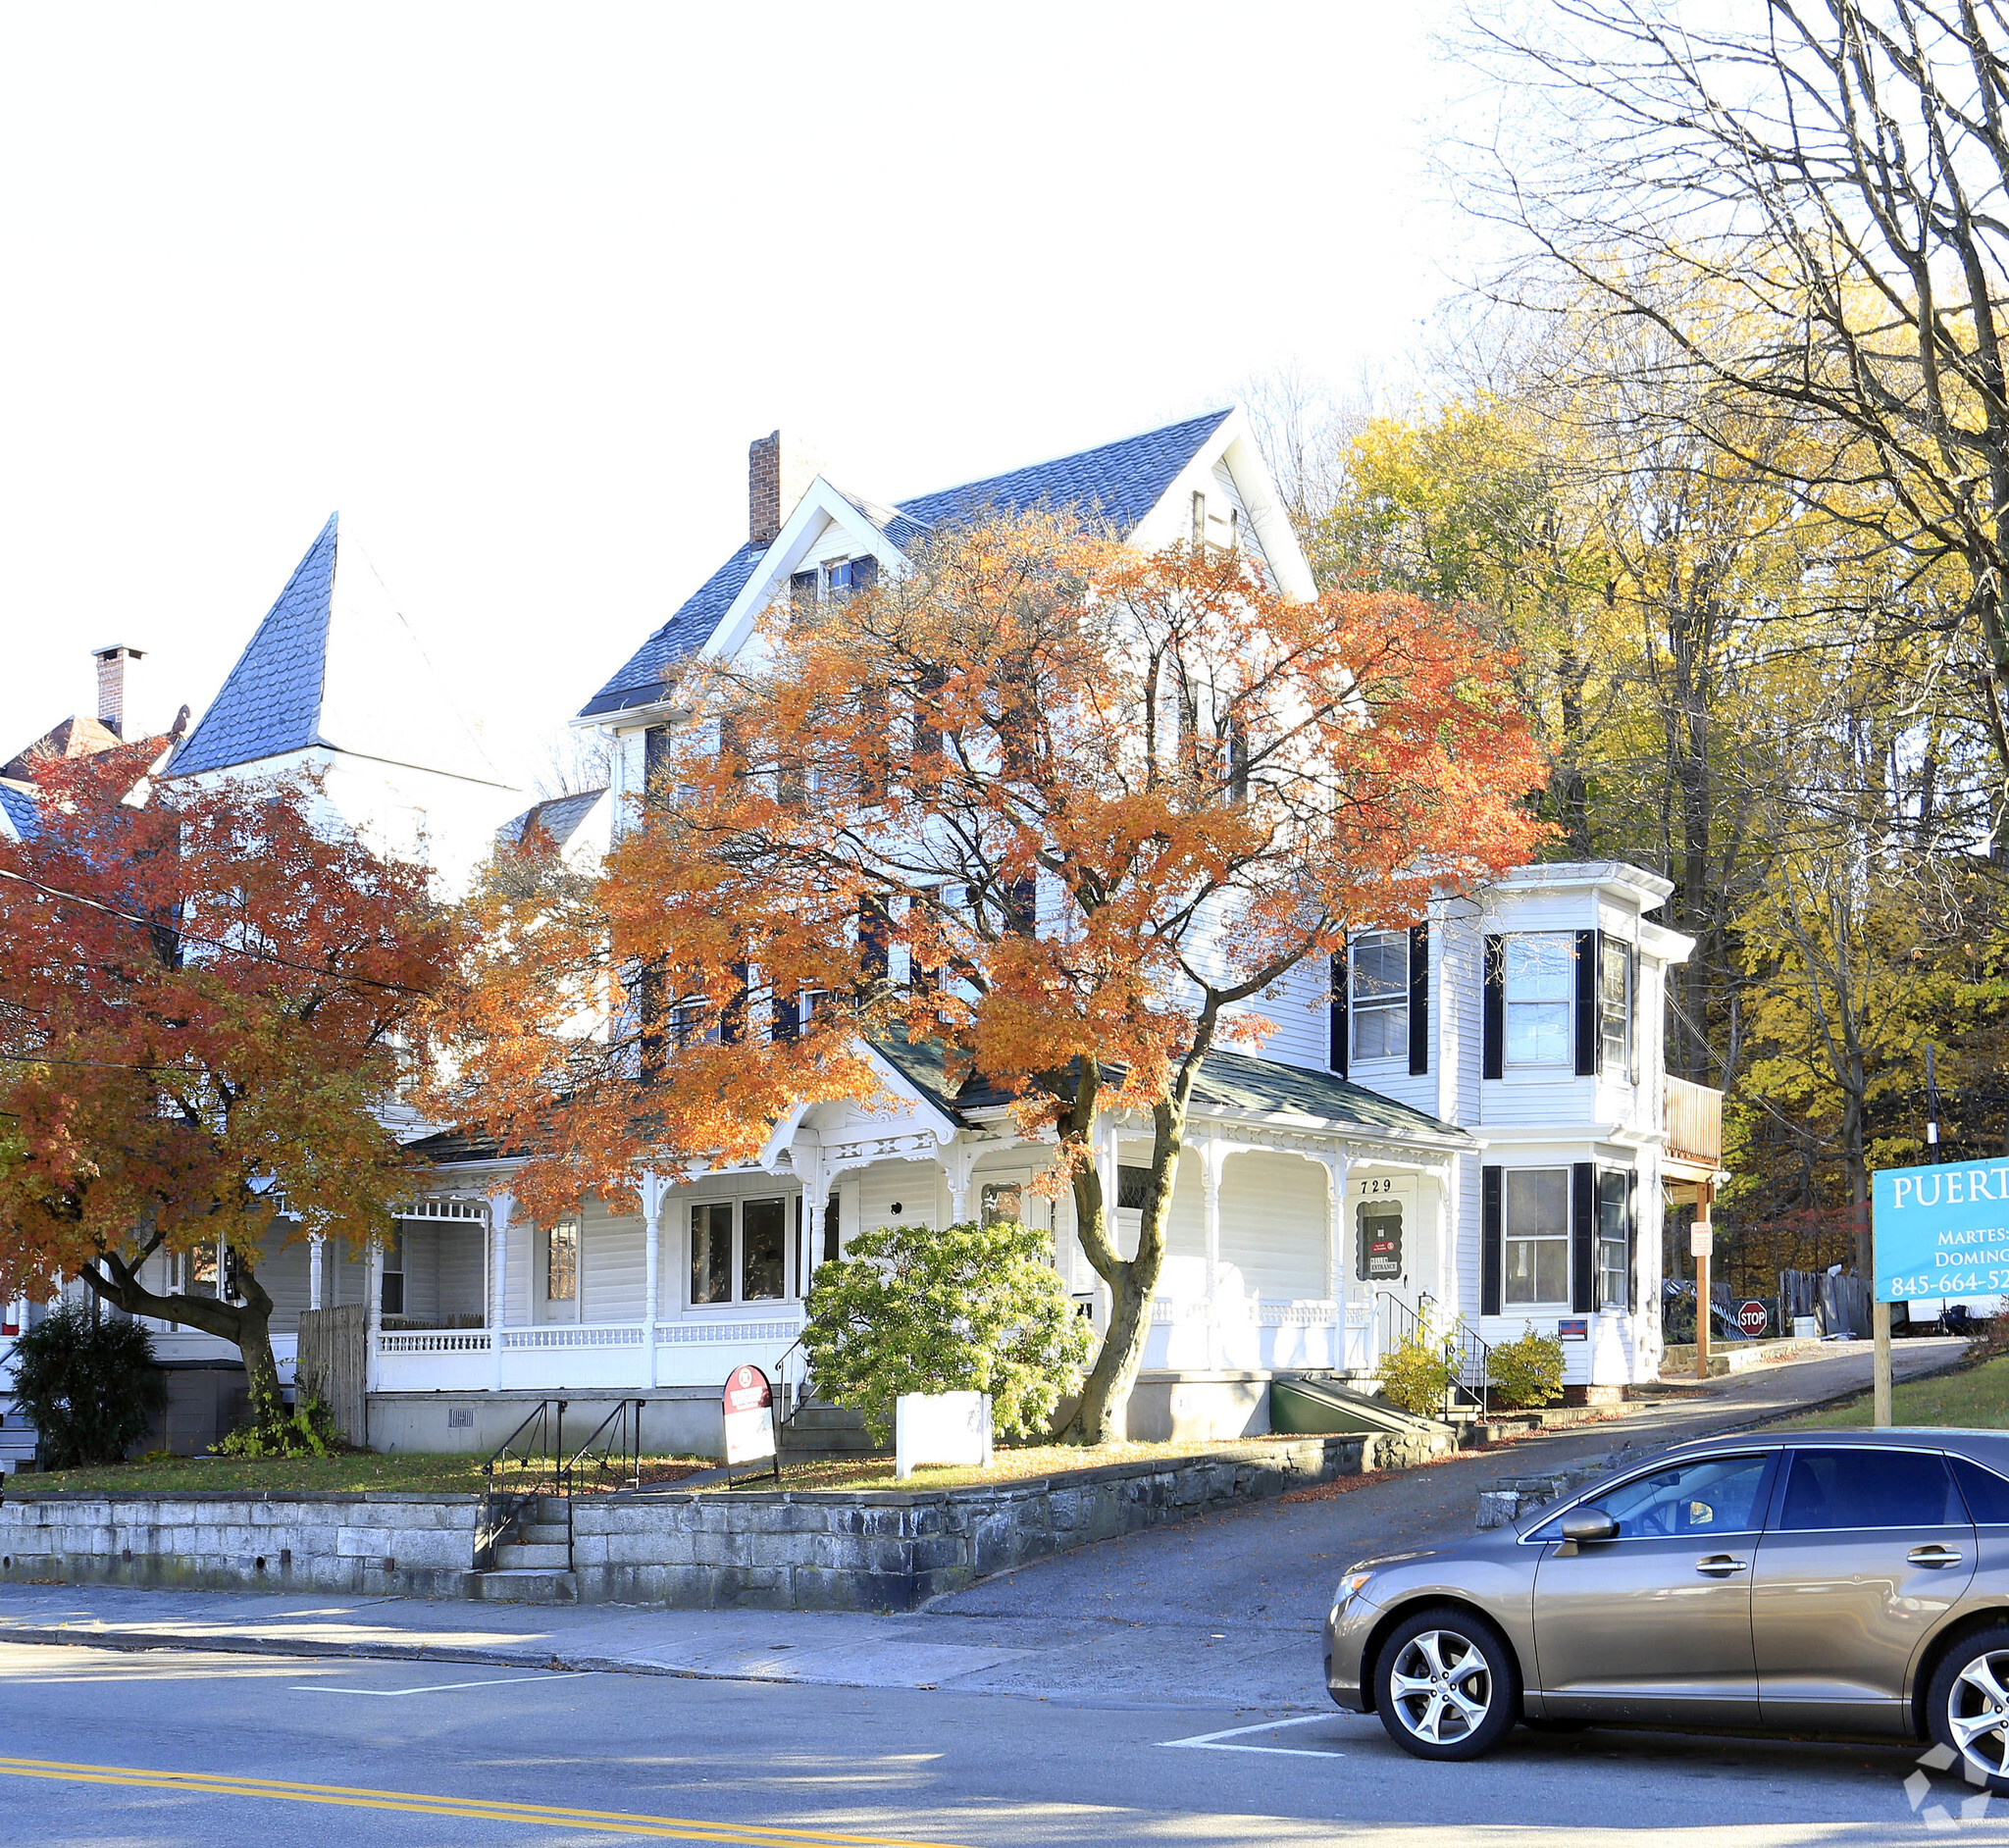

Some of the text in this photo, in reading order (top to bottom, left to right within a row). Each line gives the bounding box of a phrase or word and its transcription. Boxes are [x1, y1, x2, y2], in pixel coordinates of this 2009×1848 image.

[1361, 1179, 1391, 1194] 729
[1892, 1167, 2009, 1208] PUERT
[1891, 1269, 2009, 1297] 845-664-52
[1740, 1311, 1766, 1325] STOP
